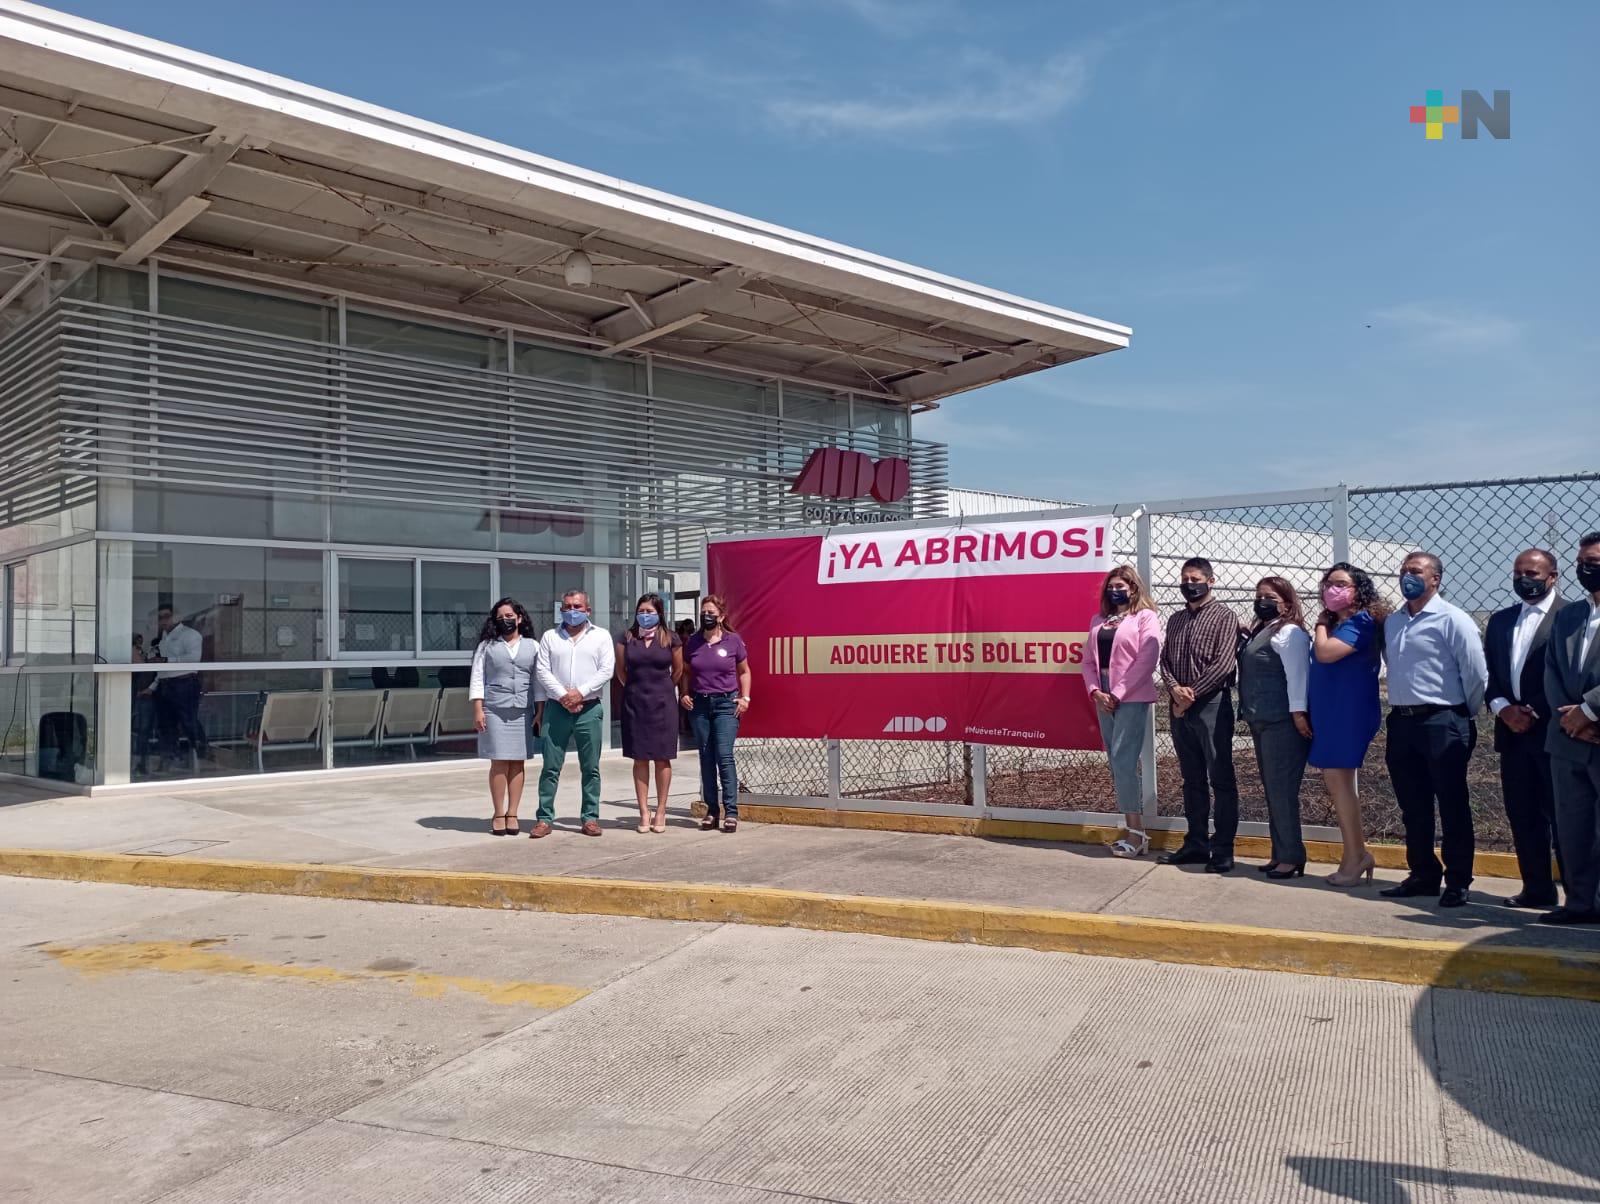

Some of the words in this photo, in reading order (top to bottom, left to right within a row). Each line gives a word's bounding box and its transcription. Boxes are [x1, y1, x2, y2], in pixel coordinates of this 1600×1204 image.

[789, 447, 910, 503] ADO
[827, 541, 883, 578] ¡YA
[894, 526, 1105, 567] ABRIMOS!
[829, 643, 928, 665] ADQUIERE
[934, 642, 975, 664] TUS
[981, 642, 1084, 664] BOLETOS
[882, 716, 948, 733] ADO
